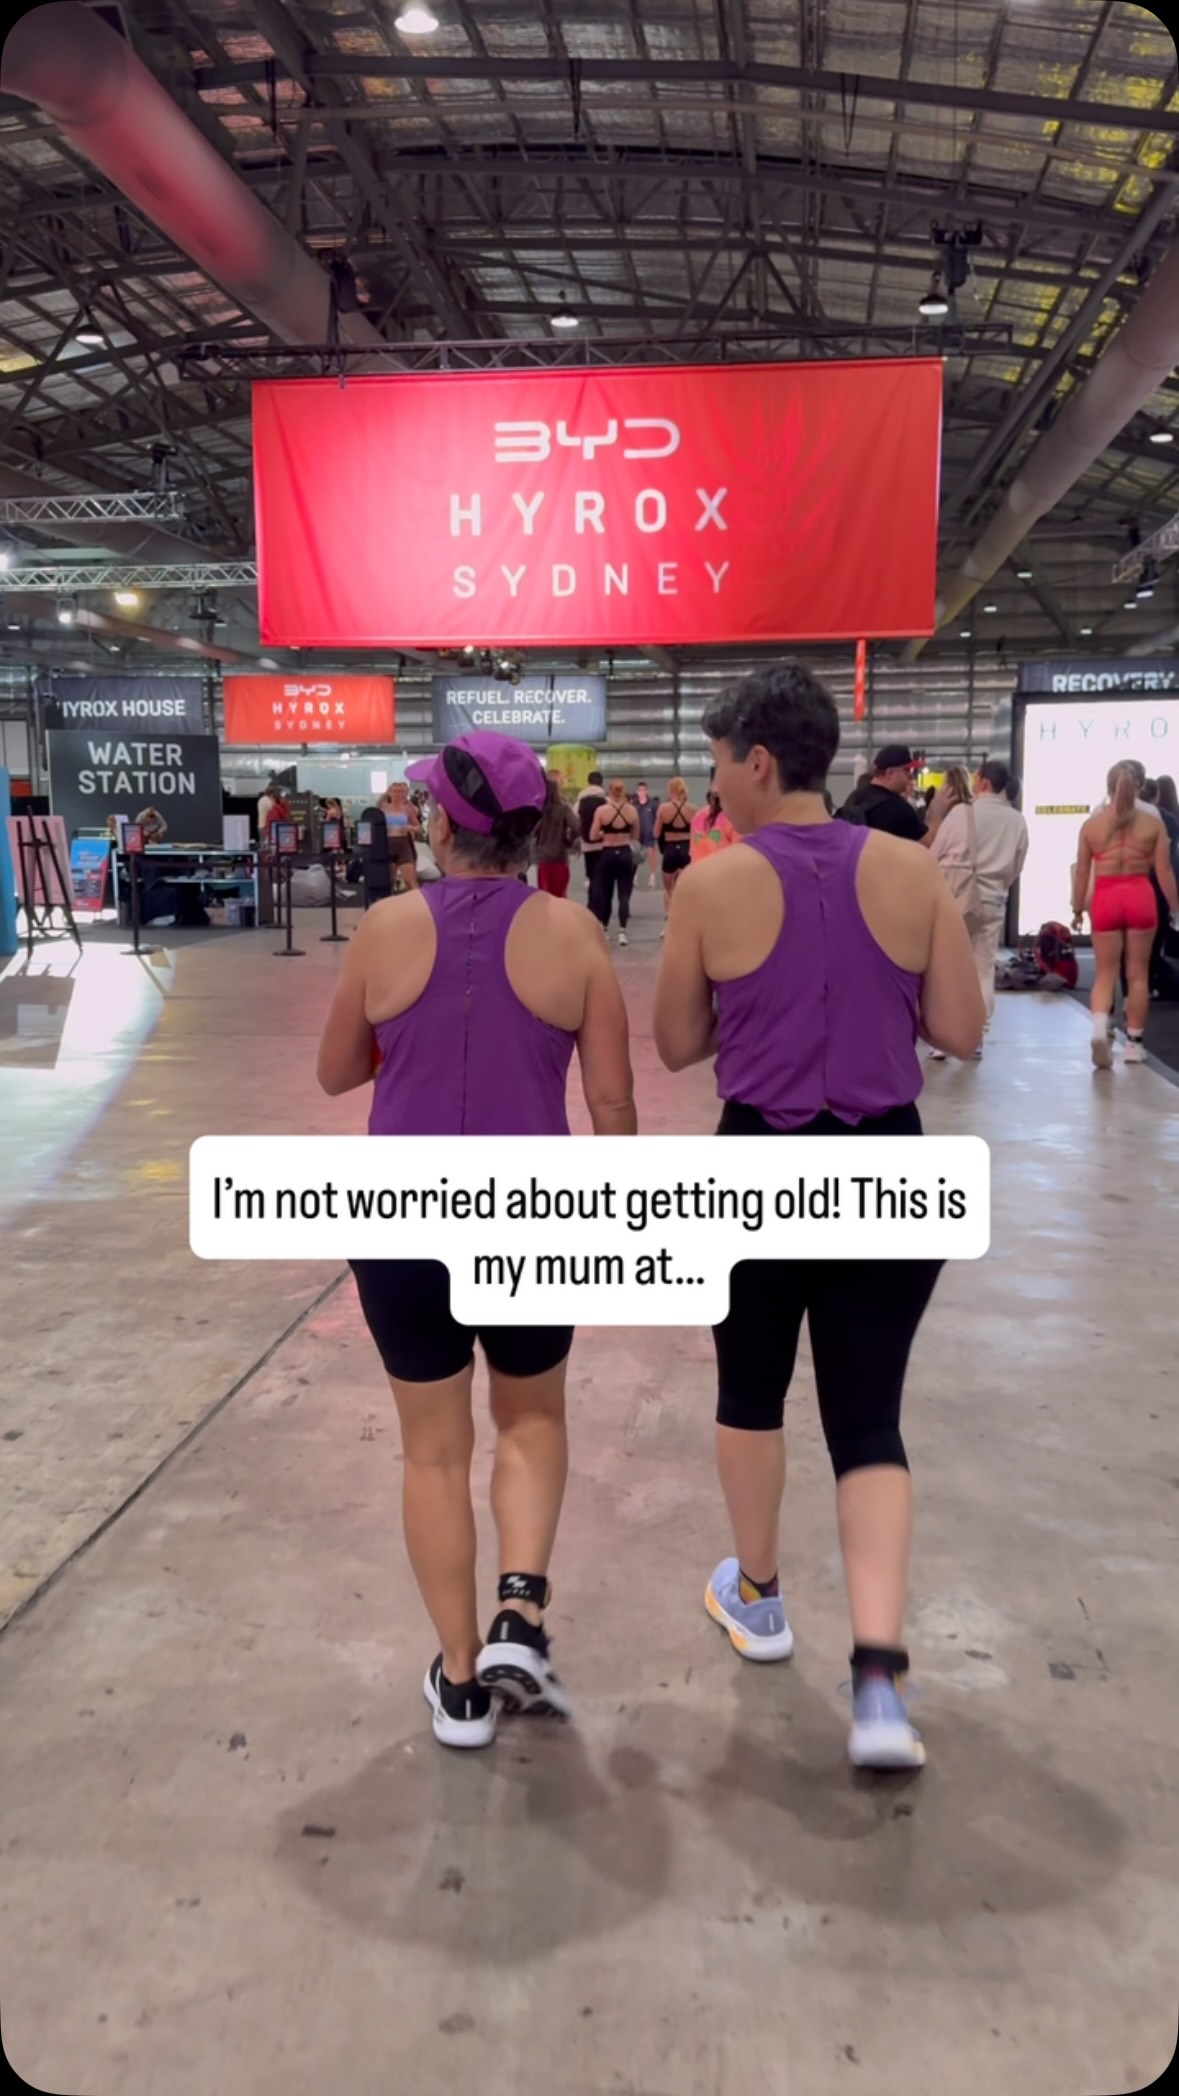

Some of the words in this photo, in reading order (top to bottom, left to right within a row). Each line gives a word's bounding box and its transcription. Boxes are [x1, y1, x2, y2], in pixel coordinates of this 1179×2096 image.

[494, 419, 681, 462] BYD
[450, 488, 728, 536] HYROX
[453, 561, 730, 598] SYDNEY
[283, 684, 332, 697] BYD
[446, 690, 510, 705] REFUEL.
[514, 688, 592, 704] RECOVER.
[122, 699, 186, 717] HOUSE
[272, 702, 345, 715] HYROX
[472, 709, 566, 725] CELEBRATE.
[274, 719, 346, 731] SYDNEY
[87, 741, 183, 766] WATER
[78, 770, 196, 795] STATION
